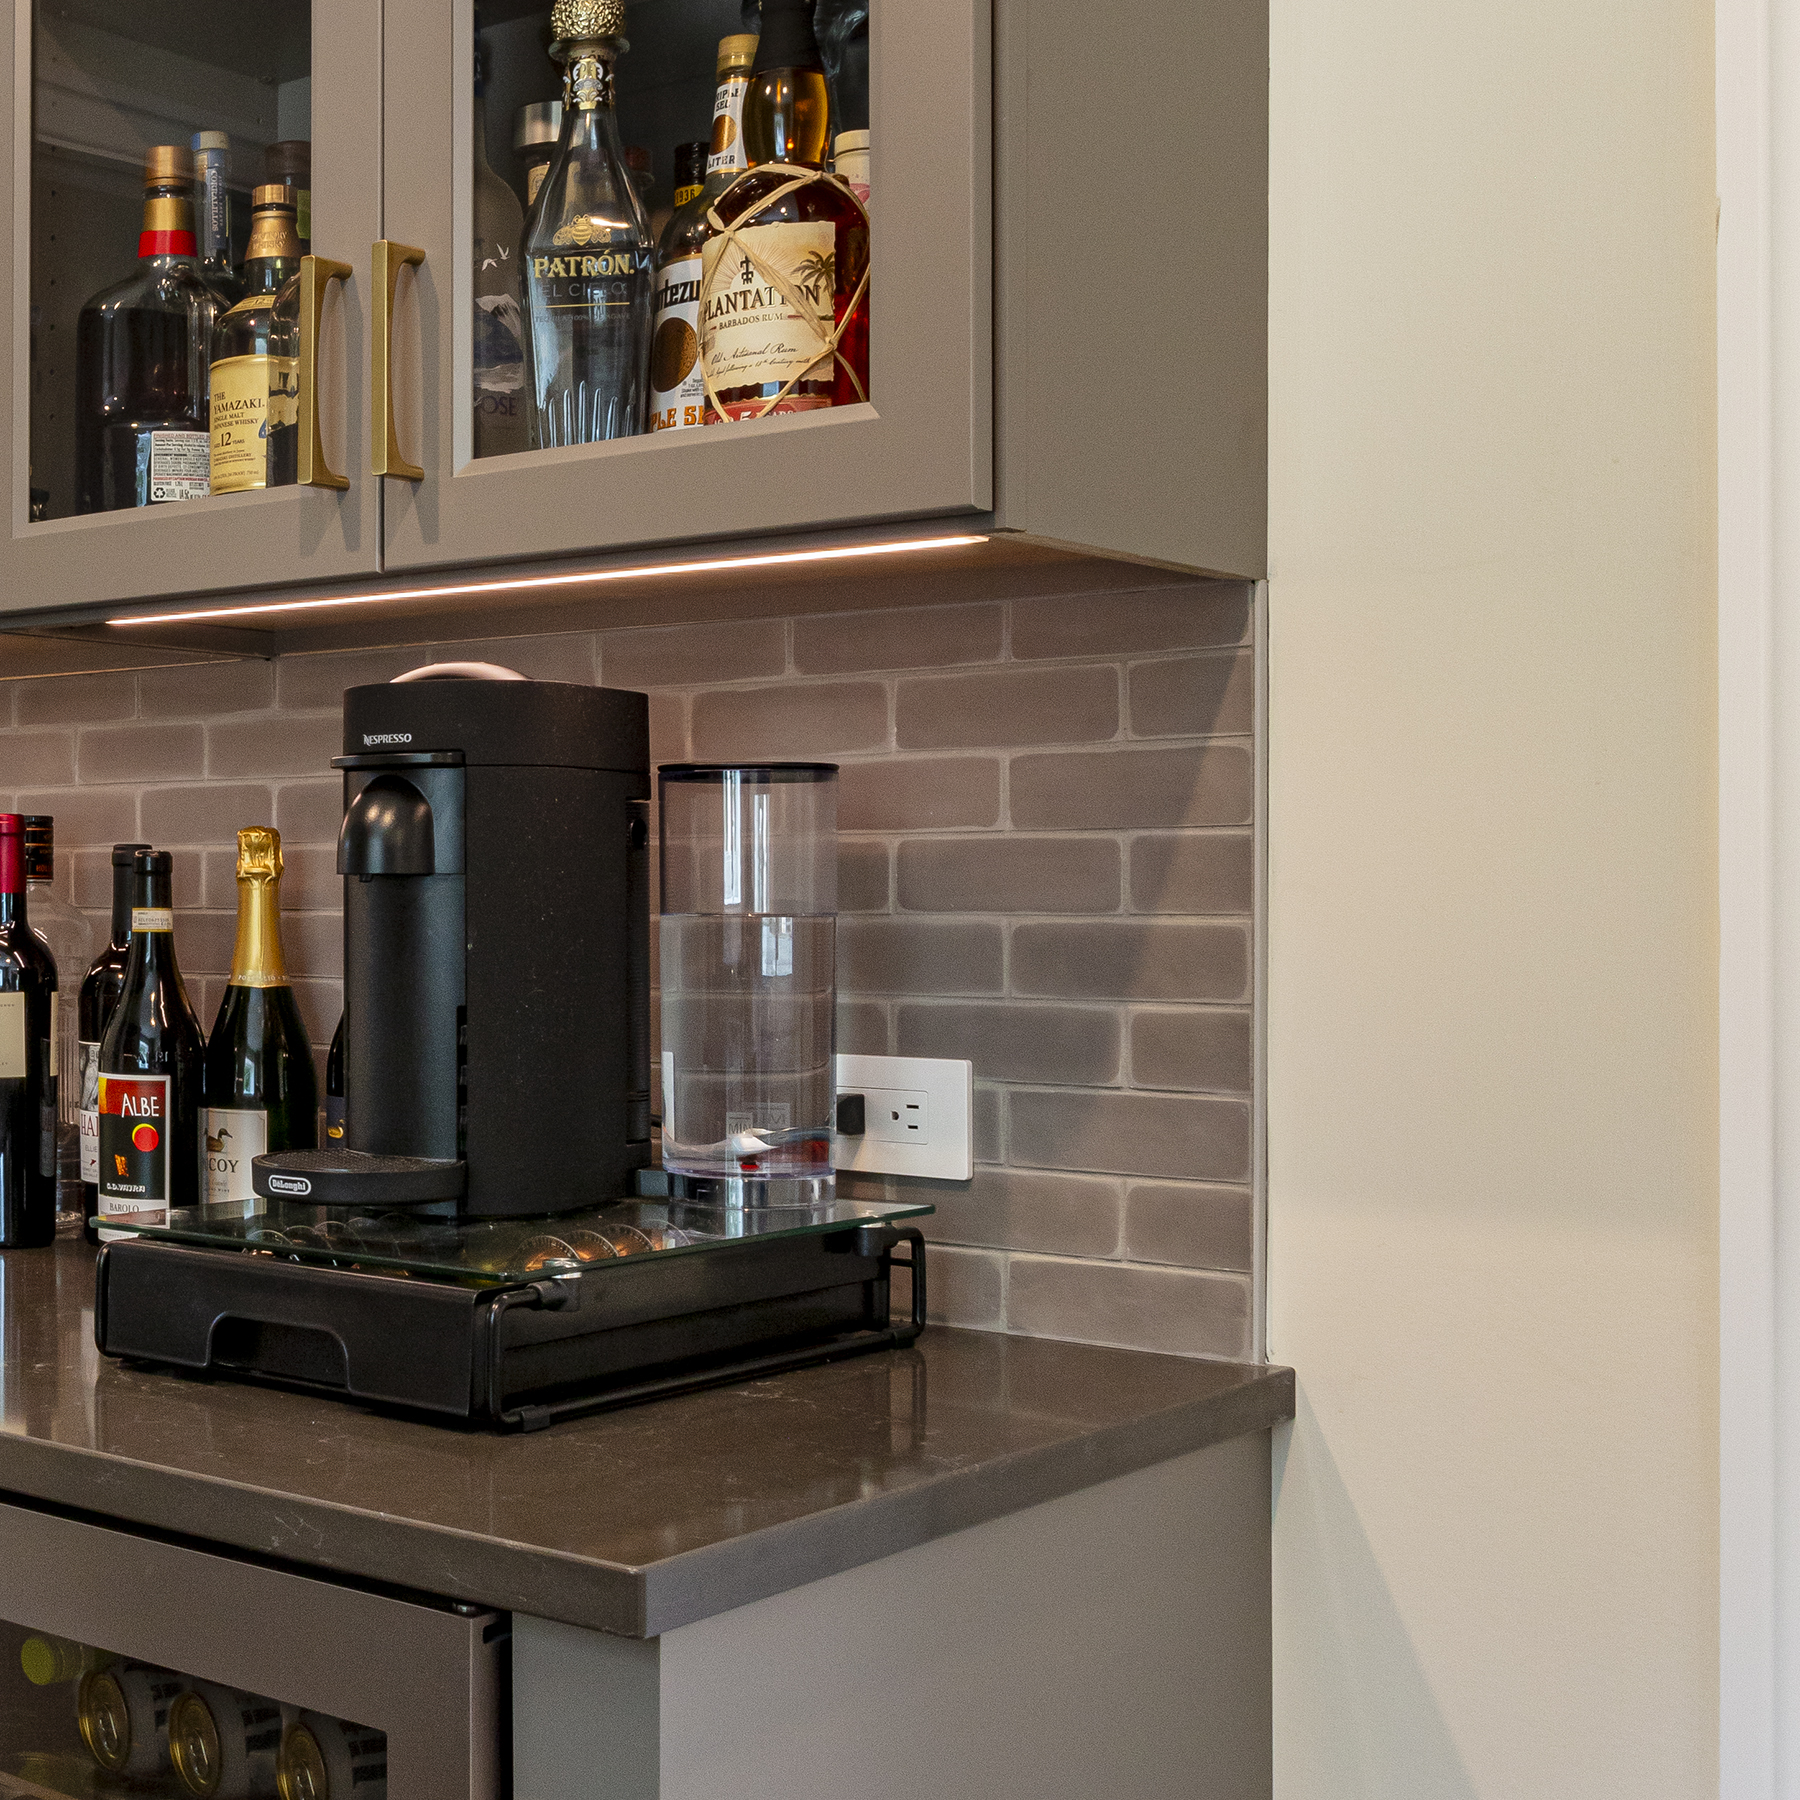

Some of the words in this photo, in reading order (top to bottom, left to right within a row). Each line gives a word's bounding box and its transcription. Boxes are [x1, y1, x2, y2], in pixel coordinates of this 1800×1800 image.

[718, 314, 761, 331] BARBADOS
[761, 312, 784, 323] RUM
[771, 341, 799, 354] Rum
[214, 391, 227, 403] THE
[228, 410, 245, 420] MALT
[234, 418, 260, 427] WHISKY
[220, 431, 232, 448] 12
[362, 733, 413, 747] NESPRESSO
[121, 1091, 161, 1119] ALBE
[109, 1201, 141, 1214] BAROLO
